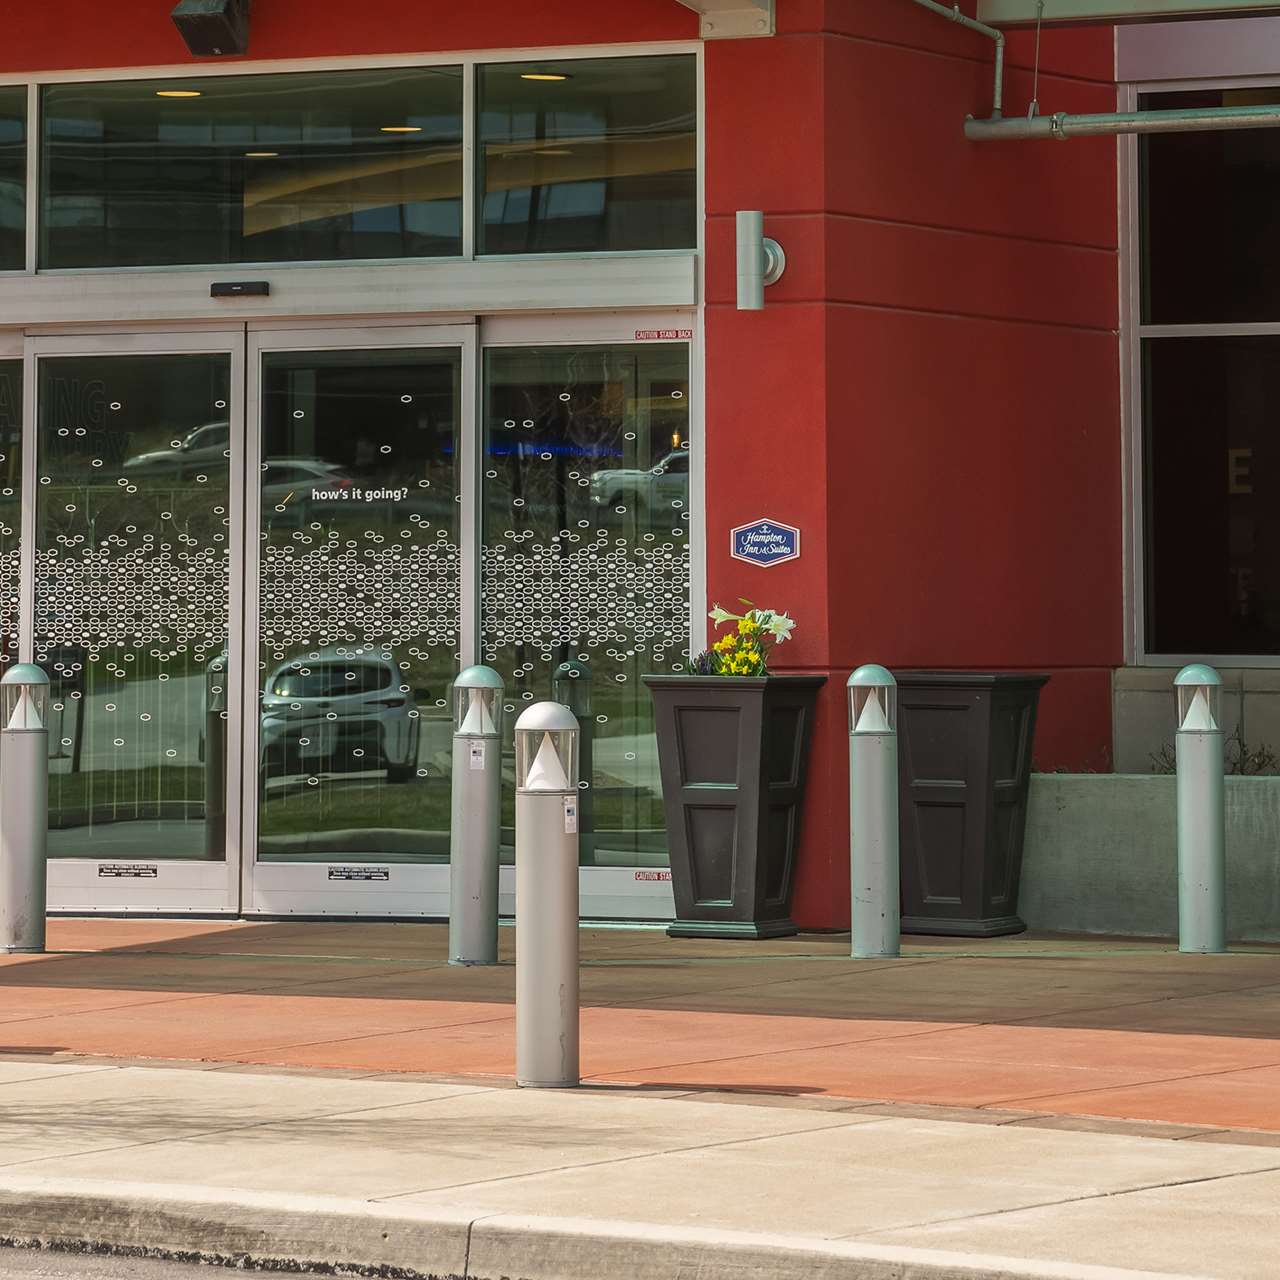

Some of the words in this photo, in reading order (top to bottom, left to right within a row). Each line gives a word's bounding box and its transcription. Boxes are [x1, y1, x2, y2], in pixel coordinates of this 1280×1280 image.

[636, 331, 658, 339] CAUTION
[659, 330, 676, 339] STAND
[678, 329, 692, 338] BACK
[311, 488, 349, 500] how's
[352, 487, 362, 499] it
[365, 487, 409, 502] going?
[741, 531, 787, 545] Hampton
[739, 543, 761, 555] Inn
[767, 543, 791, 554] Suites
[636, 872, 658, 880] CAUTION
